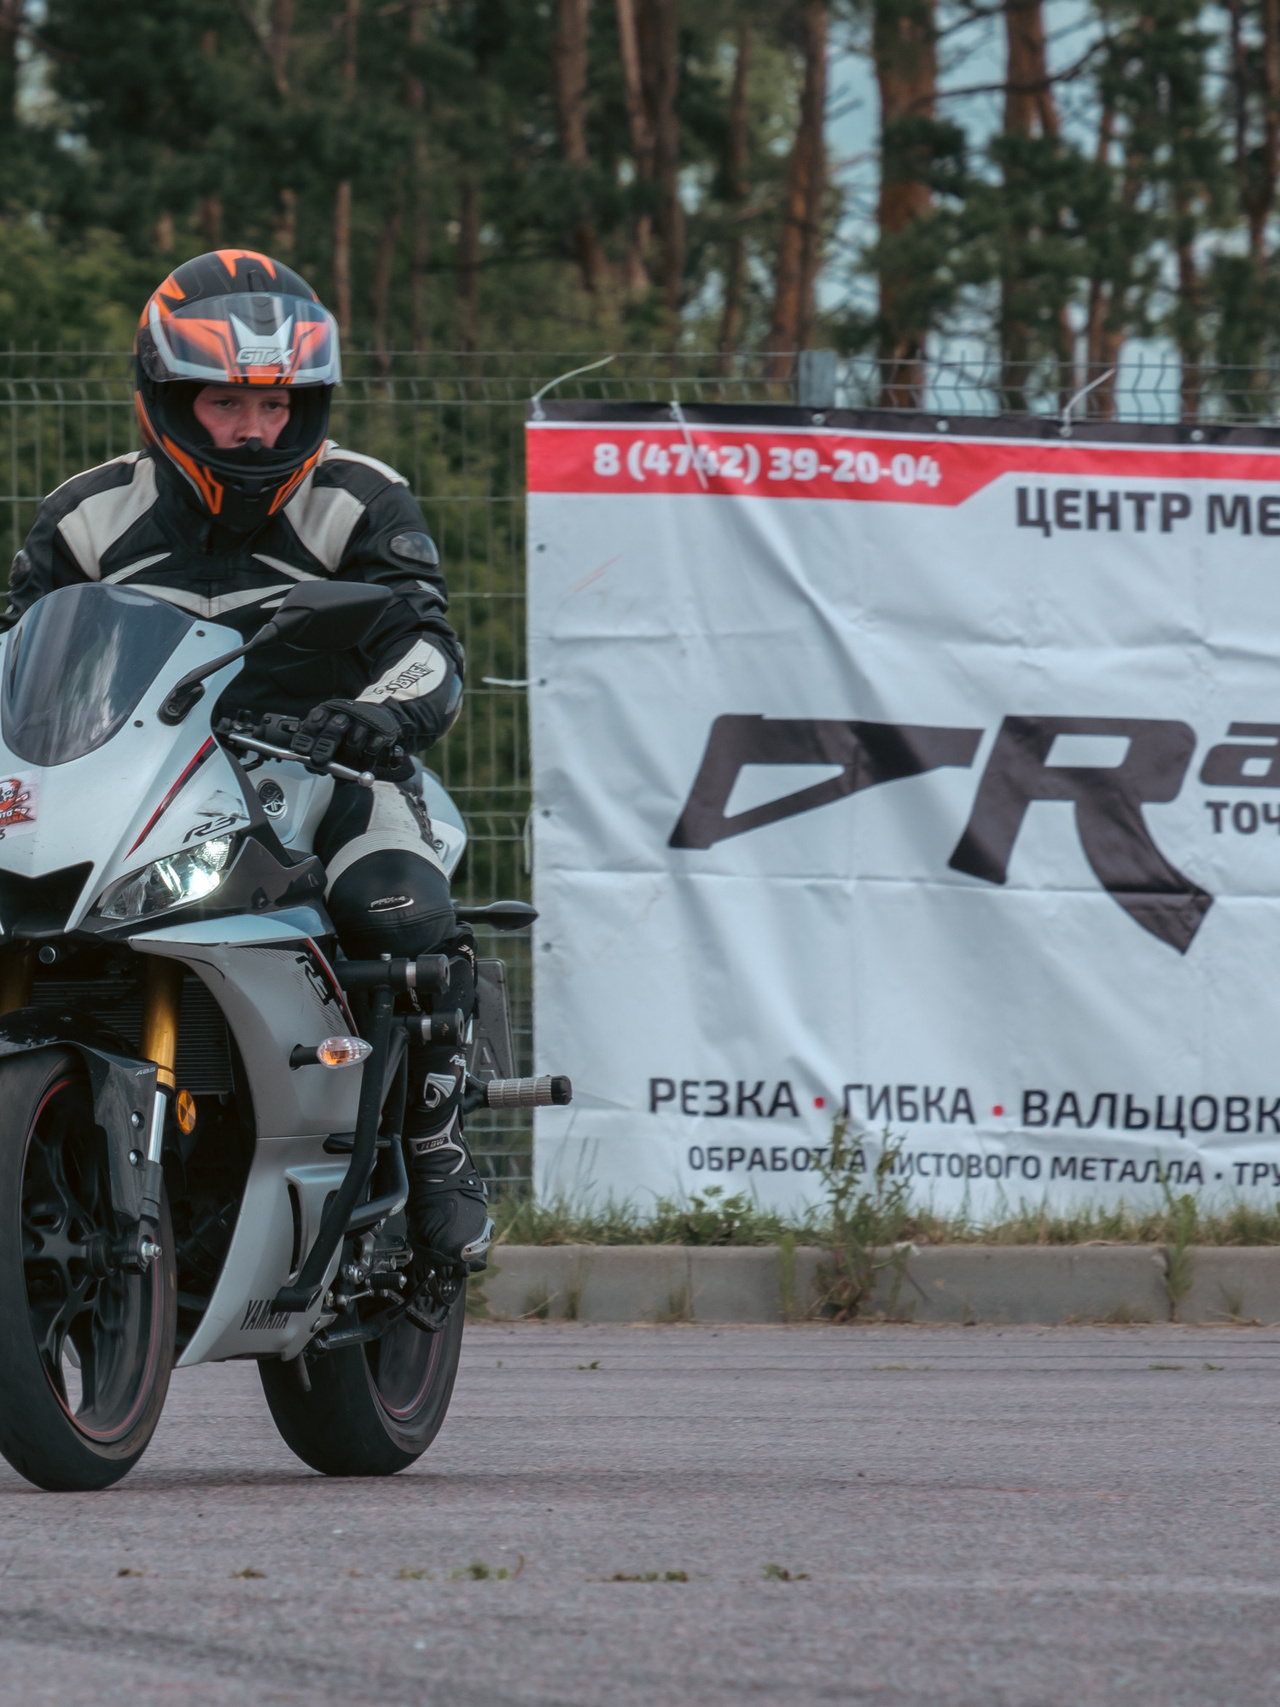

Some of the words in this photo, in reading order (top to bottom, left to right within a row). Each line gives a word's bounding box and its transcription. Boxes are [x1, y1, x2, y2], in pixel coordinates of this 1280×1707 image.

[236, 347, 296, 367] GTX
[593, 444, 620, 477] 8
[627, 442, 761, 484] (4742)
[767, 446, 942, 488] 39-20-04
[1016, 486, 1192, 536] ЦЕНТР
[1207, 493, 1280, 537] МЕ
[182, 815, 238, 844] R3
[134, 1066, 156, 1077] ABS
[648, 1077, 801, 1118] РЕЗКА
[842, 1083, 977, 1125] ГИБКА
[1022, 1089, 1280, 1140] ВАЛЬЦОВК
[1051, 1155, 1204, 1187] МЕТАЛЛА
